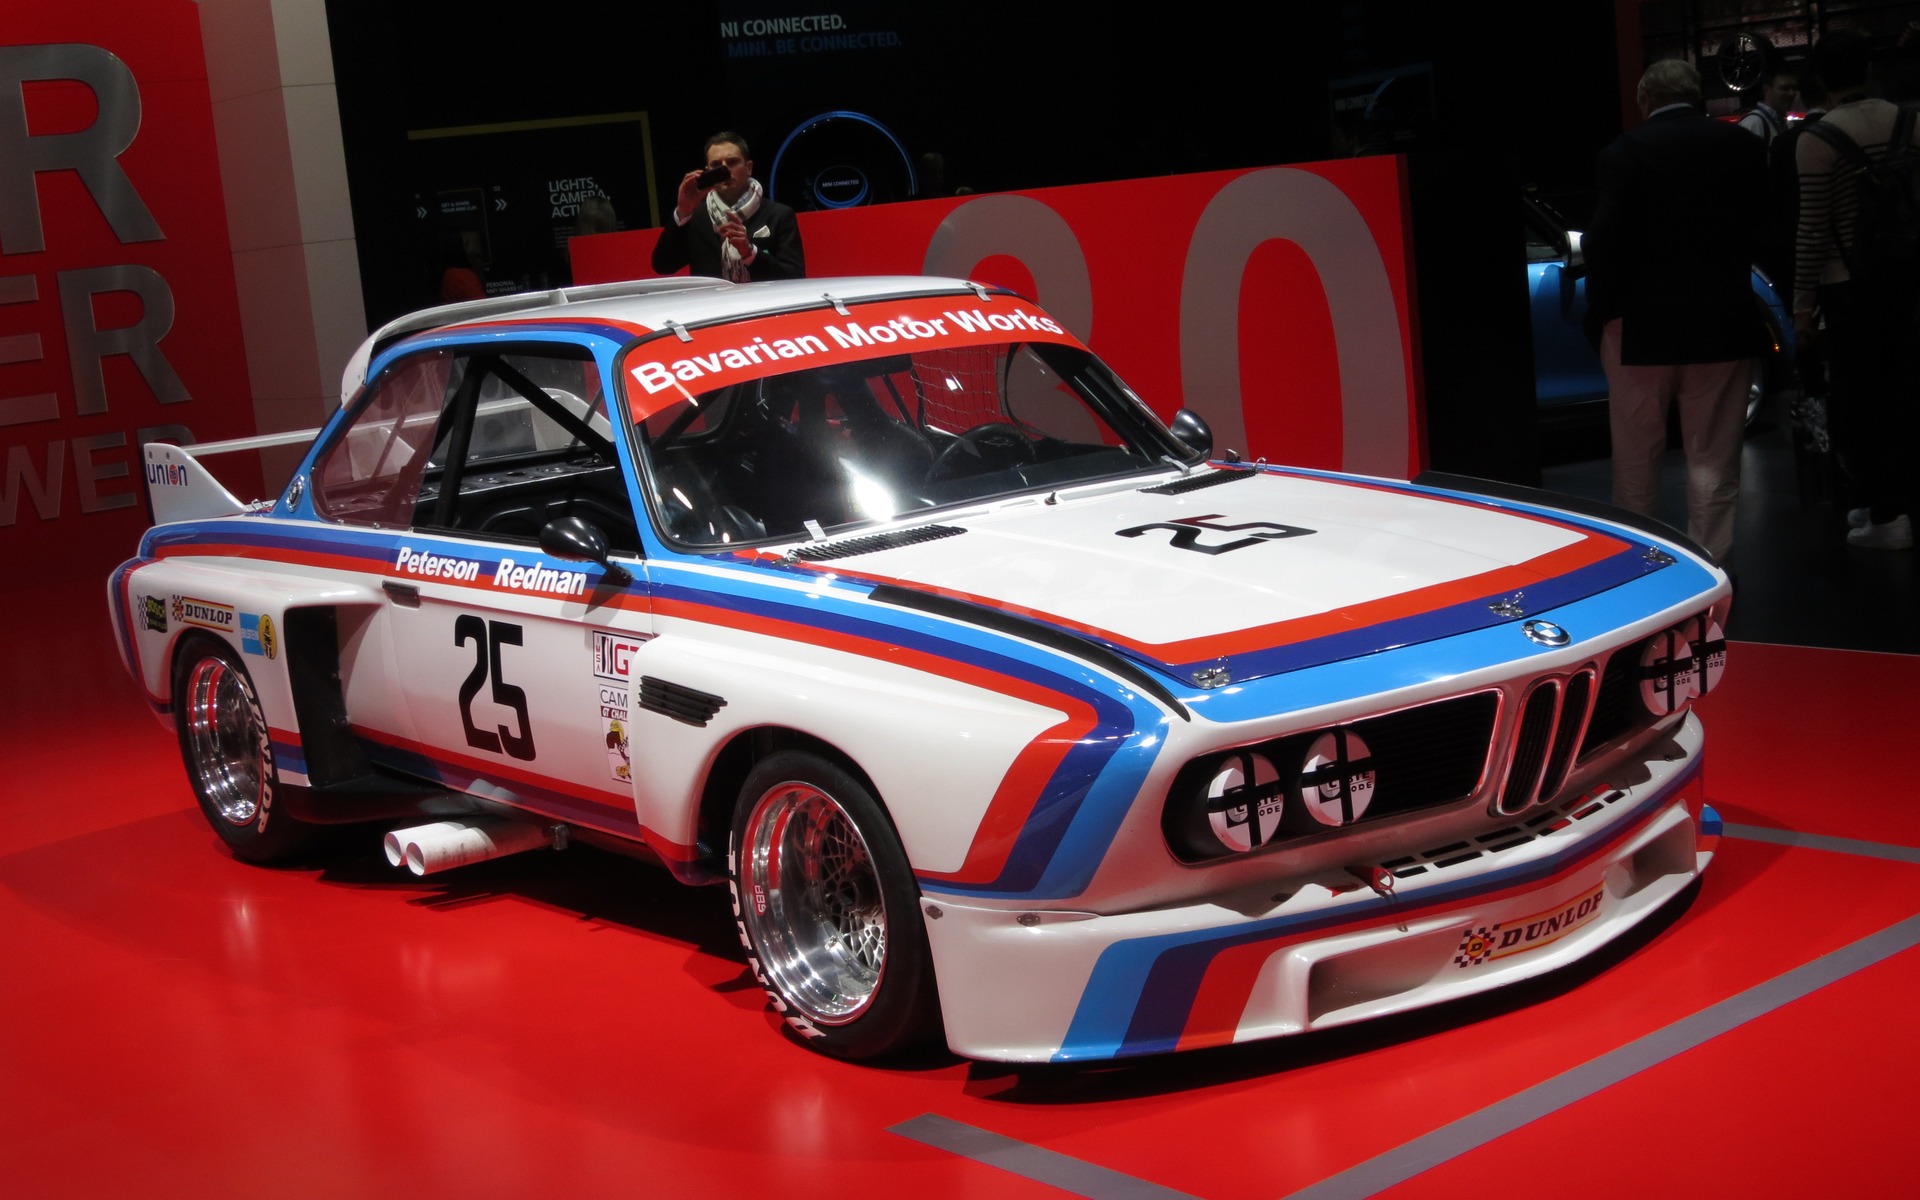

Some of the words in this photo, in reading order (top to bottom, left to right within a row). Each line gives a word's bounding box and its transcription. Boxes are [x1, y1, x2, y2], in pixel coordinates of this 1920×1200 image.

[743, 14, 847, 37] CONNECTED.
[727, 40, 772, 59] MINI.
[775, 38, 797, 55] BE
[800, 31, 902, 54] CONNECTED.
[548, 176, 600, 193] LIGHTS,
[630, 333, 828, 395] Bavarian
[824, 315, 948, 351] Motor
[943, 309, 1064, 336] Works
[147, 463, 187, 487] union
[1115, 514, 1318, 556] 25
[395, 546, 480, 582] Peterson
[493, 558, 587, 596] Redman
[185, 603, 233, 625] DUNLOP
[455, 614, 537, 762] 25
[600, 689, 628, 709] CAM
[602, 707, 610, 717] GT
[754, 884, 767, 913] BBS
[1498, 889, 1604, 949] DUNLOP
